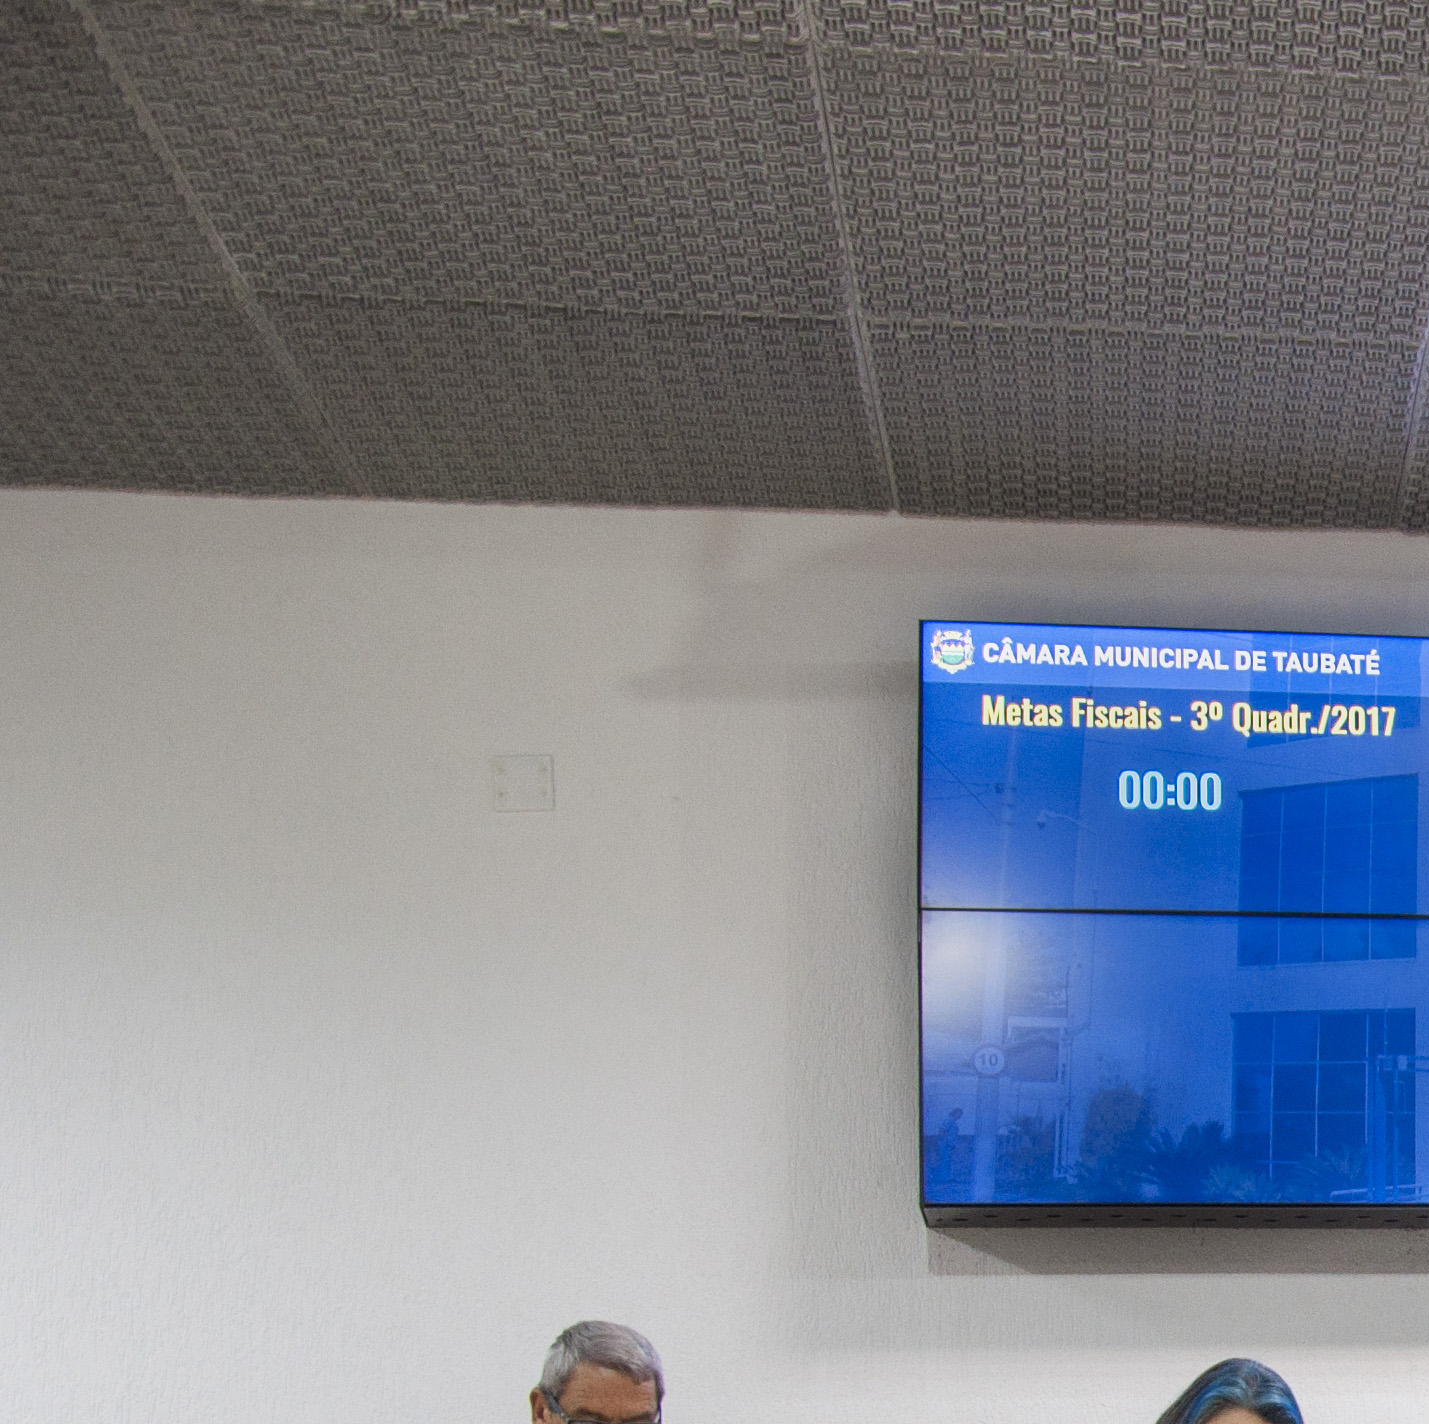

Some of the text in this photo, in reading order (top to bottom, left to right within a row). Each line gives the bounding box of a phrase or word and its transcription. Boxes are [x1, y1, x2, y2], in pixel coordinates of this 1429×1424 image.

[983, 637, 1380, 675] CÂMARA MUNICIPAL DE TAUBATÉ
[982, 694, 1063, 727] Metas
[1071, 697, 1162, 730] Fiscais
[1232, 702, 1396, 737] Quadr./2017
[1118, 770, 1222, 810] 00:00
